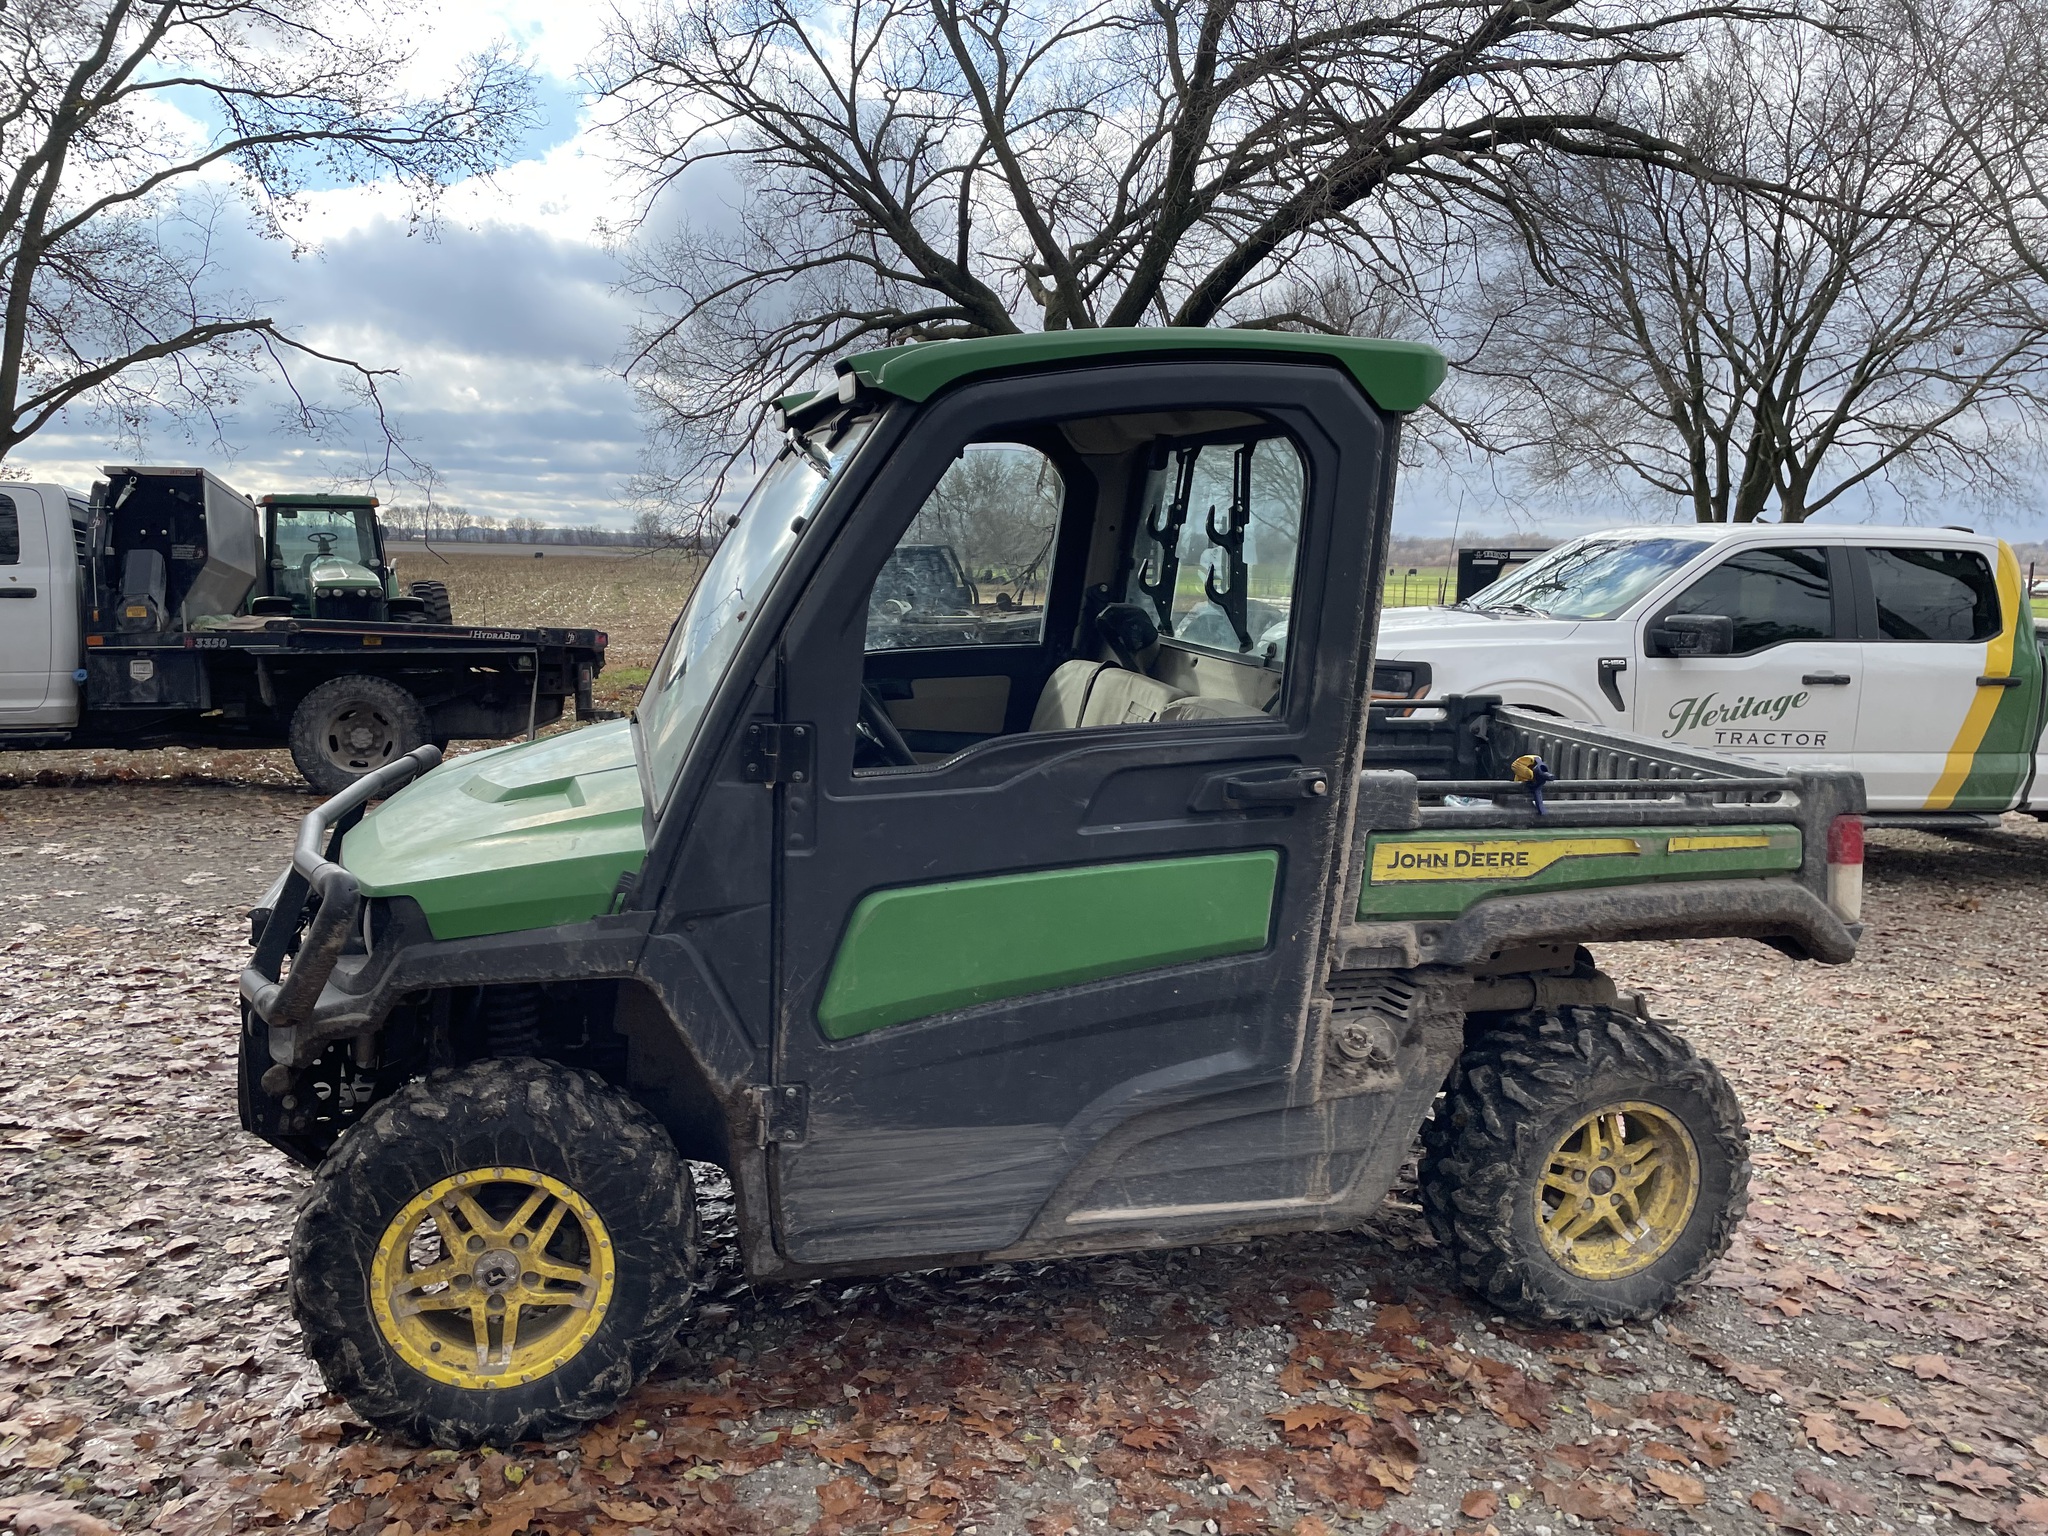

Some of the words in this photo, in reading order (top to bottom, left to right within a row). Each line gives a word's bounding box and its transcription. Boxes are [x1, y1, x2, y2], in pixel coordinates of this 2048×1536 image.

[194, 637, 228, 649] 3350
[1662, 691, 1812, 738] Heritage
[1715, 731, 1827, 746] TRACTOR
[1386, 850, 1449, 869] JOHN
[1454, 849, 1529, 868] DEERE
